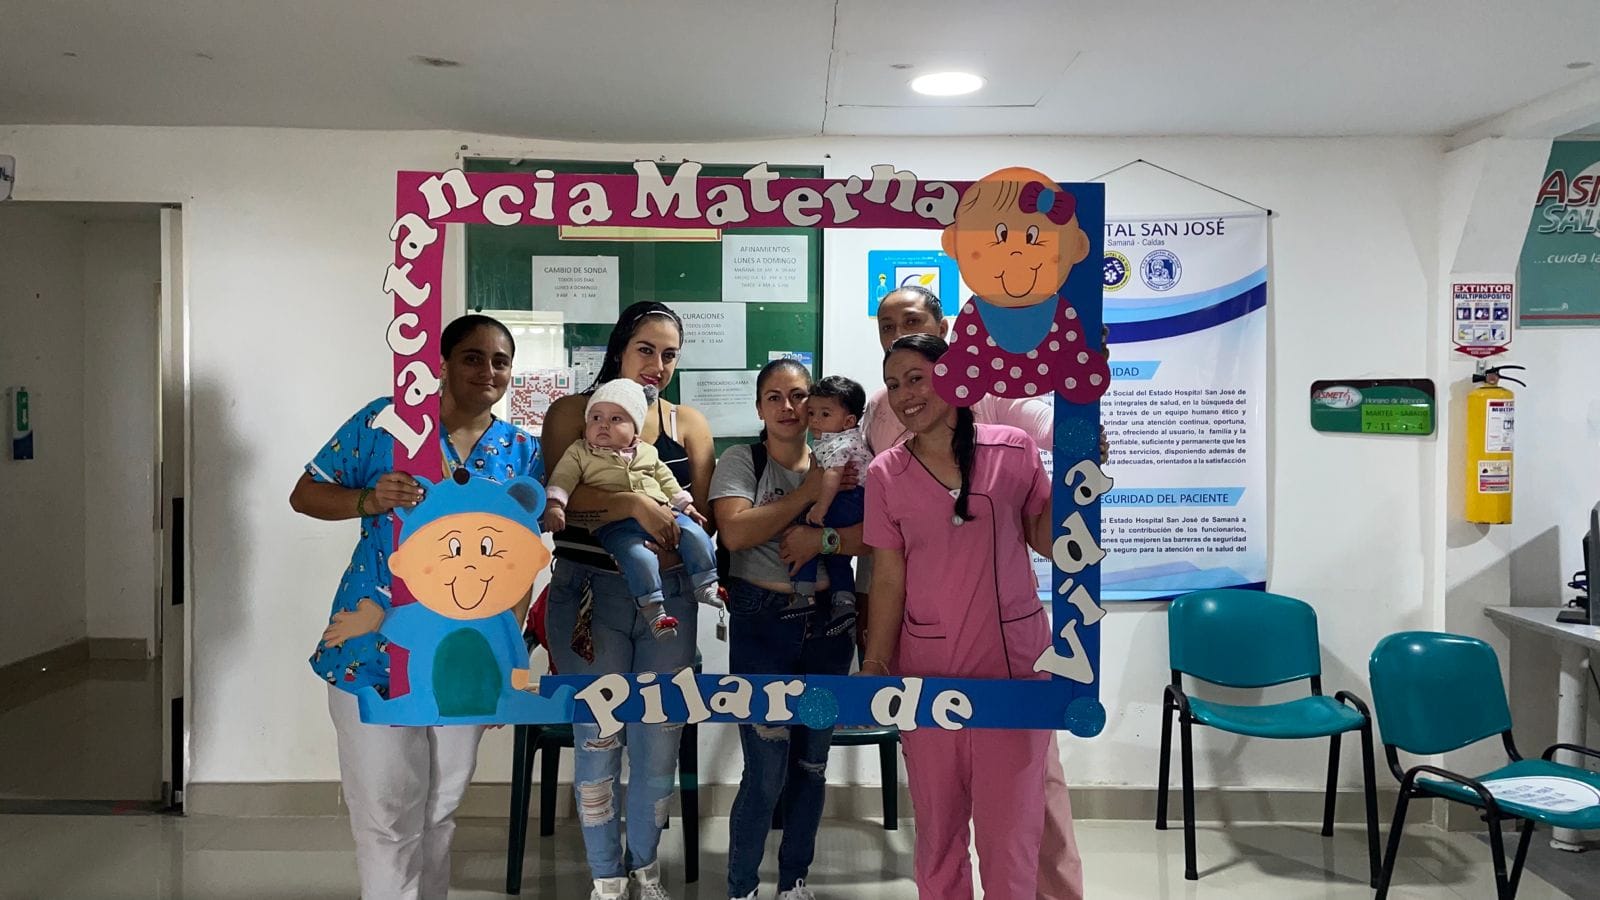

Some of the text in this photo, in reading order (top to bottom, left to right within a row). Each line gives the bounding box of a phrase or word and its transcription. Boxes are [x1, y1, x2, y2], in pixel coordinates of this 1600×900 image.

[1537, 203, 1600, 232] SAL
[1141, 222, 1178, 236] SAN
[1183, 217, 1225, 236] JOSÉ
[1107, 239, 1135, 247] Samaná
[1142, 238, 1165, 246] Caldas
[584, 266, 608, 274] SONDA
[1454, 284, 1511, 293] EXTINTOR
[371, 159, 959, 459] Lactancia Materna
[682, 312, 725, 320] CURACIONES
[1111, 367, 1140, 377] IDAD
[1174, 389, 1203, 397] Hospital
[1157, 494, 1177, 504] DEL
[1180, 493, 1229, 503] PACIENTE
[574, 458, 1115, 739] Pilar de Vida
